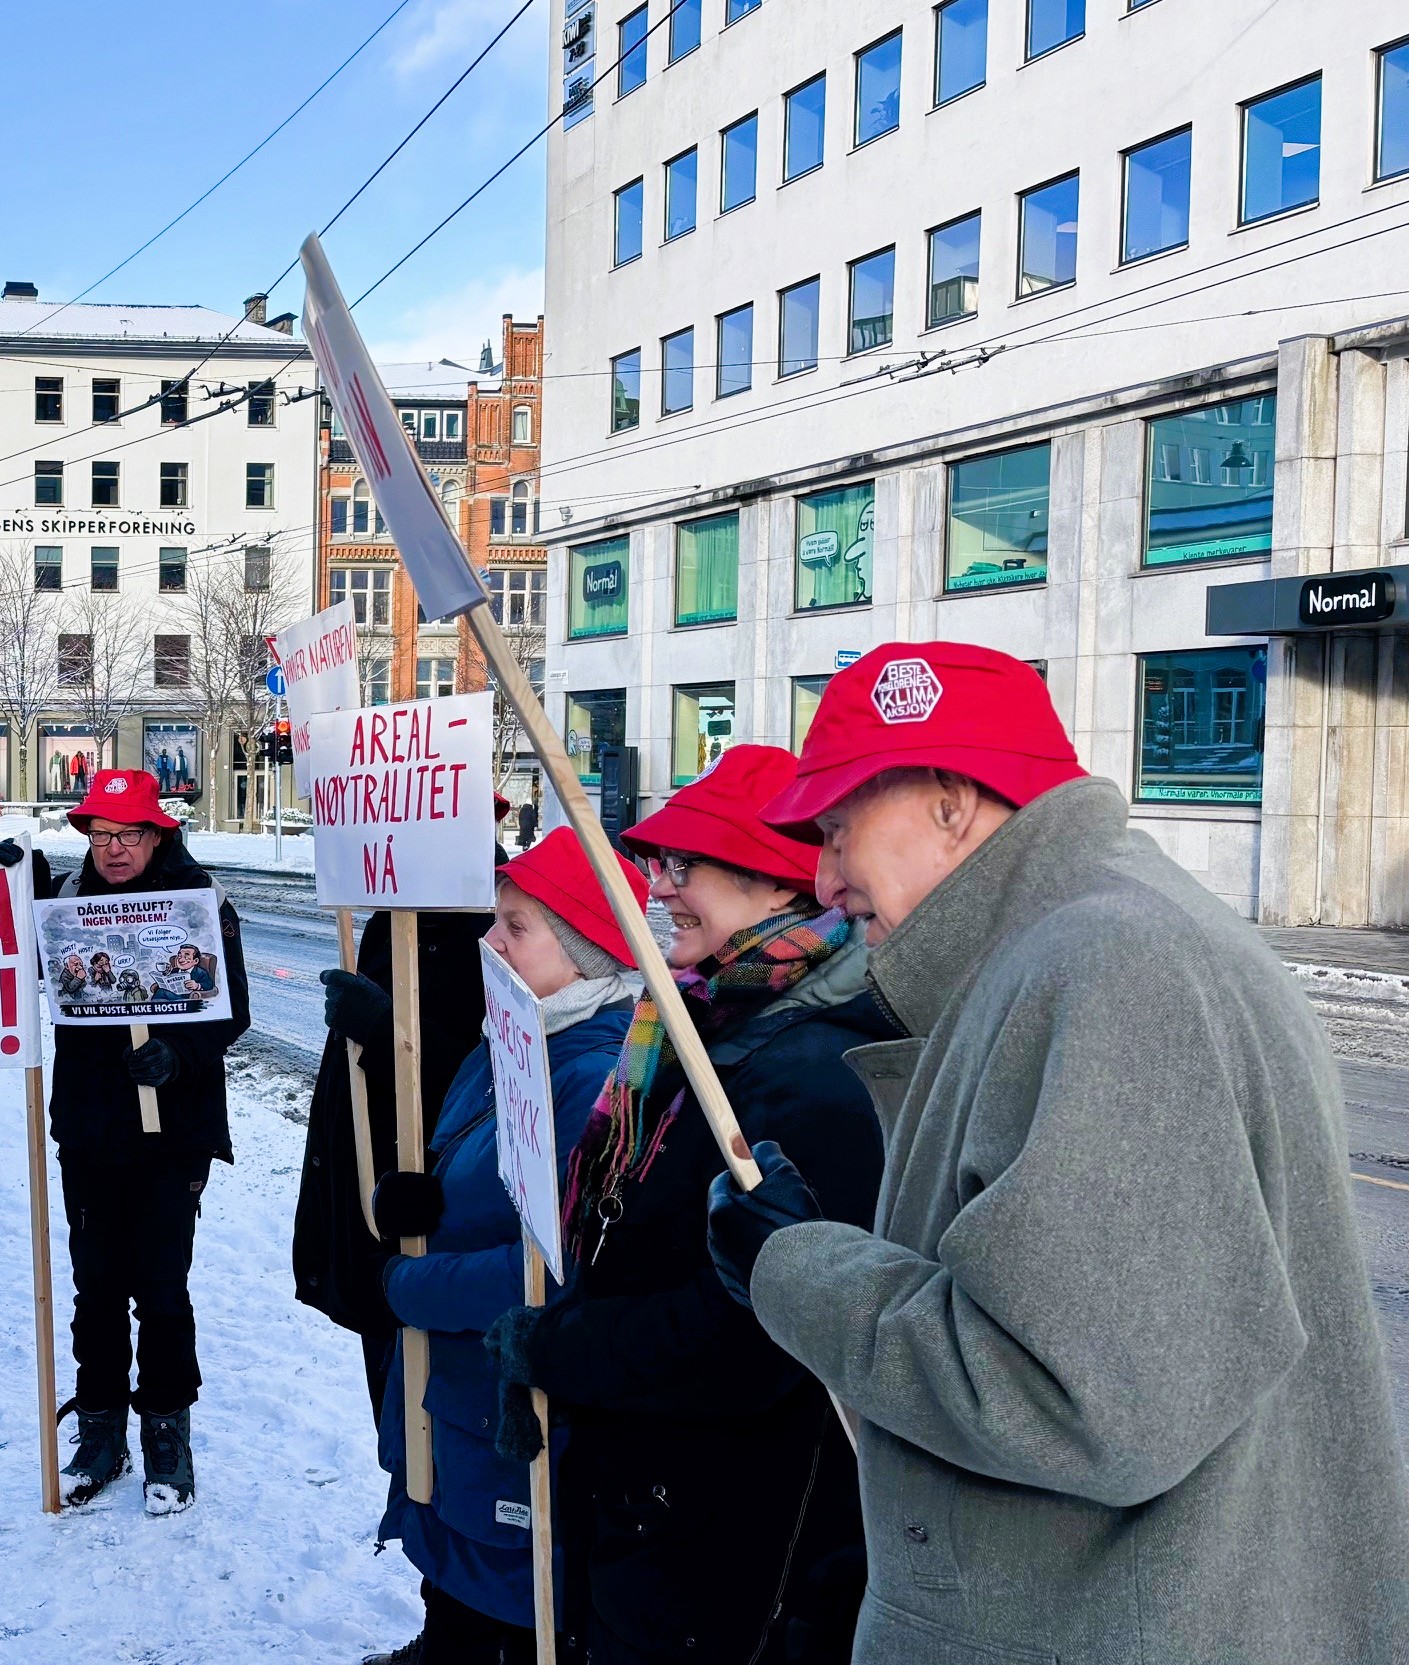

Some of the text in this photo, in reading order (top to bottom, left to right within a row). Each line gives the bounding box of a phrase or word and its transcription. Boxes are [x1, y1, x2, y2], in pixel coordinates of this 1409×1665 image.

[41, 519, 196, 535] SKIPPERFORENING
[586, 568, 618, 594] Normal
[1309, 582, 1376, 614] Normal
[308, 620, 353, 675] NATUREN
[887, 664, 922, 681] BESTE
[879, 685, 935, 710] KLIMA
[885, 701, 930, 718] AKSJON
[349, 704, 467, 767] AREAL-
[313, 763, 467, 827] NØYTRALITET
[363, 834, 398, 895] NÅ
[77, 900, 173, 916] DÅRLIG BYLUFT?
[82, 912, 168, 927] INGEN PROBLEM!
[60, 943, 76, 955] HOST!
[72, 1003, 188, 1015] VI VIL PUSTE, IKKE HOSTE!
